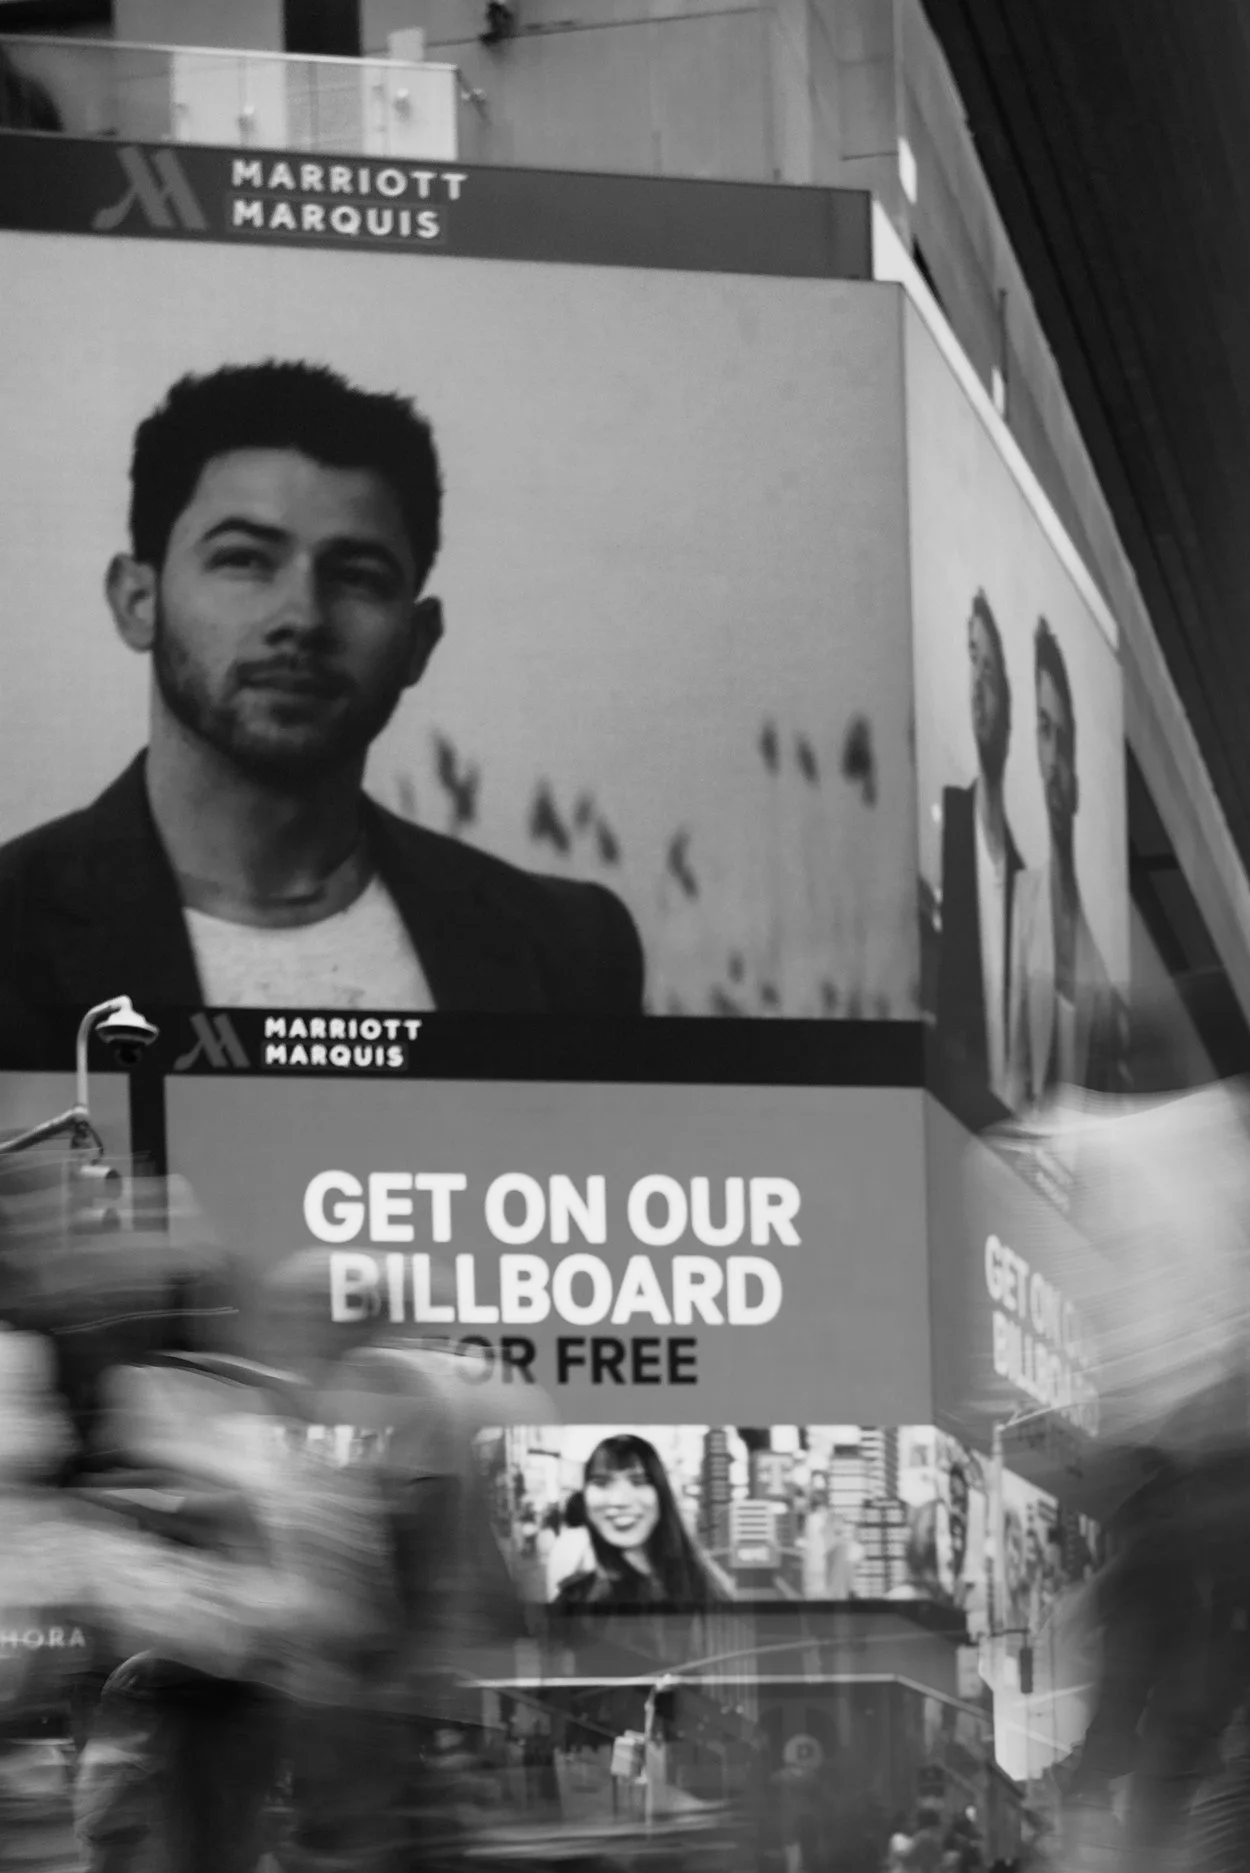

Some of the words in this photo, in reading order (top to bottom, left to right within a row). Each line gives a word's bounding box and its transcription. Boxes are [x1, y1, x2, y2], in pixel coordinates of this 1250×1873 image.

[232, 159, 468, 200] MARRIOTT
[232, 199, 442, 240] MARQUIS
[264, 1016, 422, 1041] MARRIOTT
[264, 1043, 405, 1068] MARQUIS
[302, 1169, 468, 1244] GET
[484, 1171, 608, 1246] ON
[626, 1173, 803, 1248] OUR
[329, 1252, 784, 1327] BILLBOARD
[985, 1234, 1030, 1319] GET
[555, 1335, 699, 1386] FREE
[0, 1624, 87, 1651] HORA
